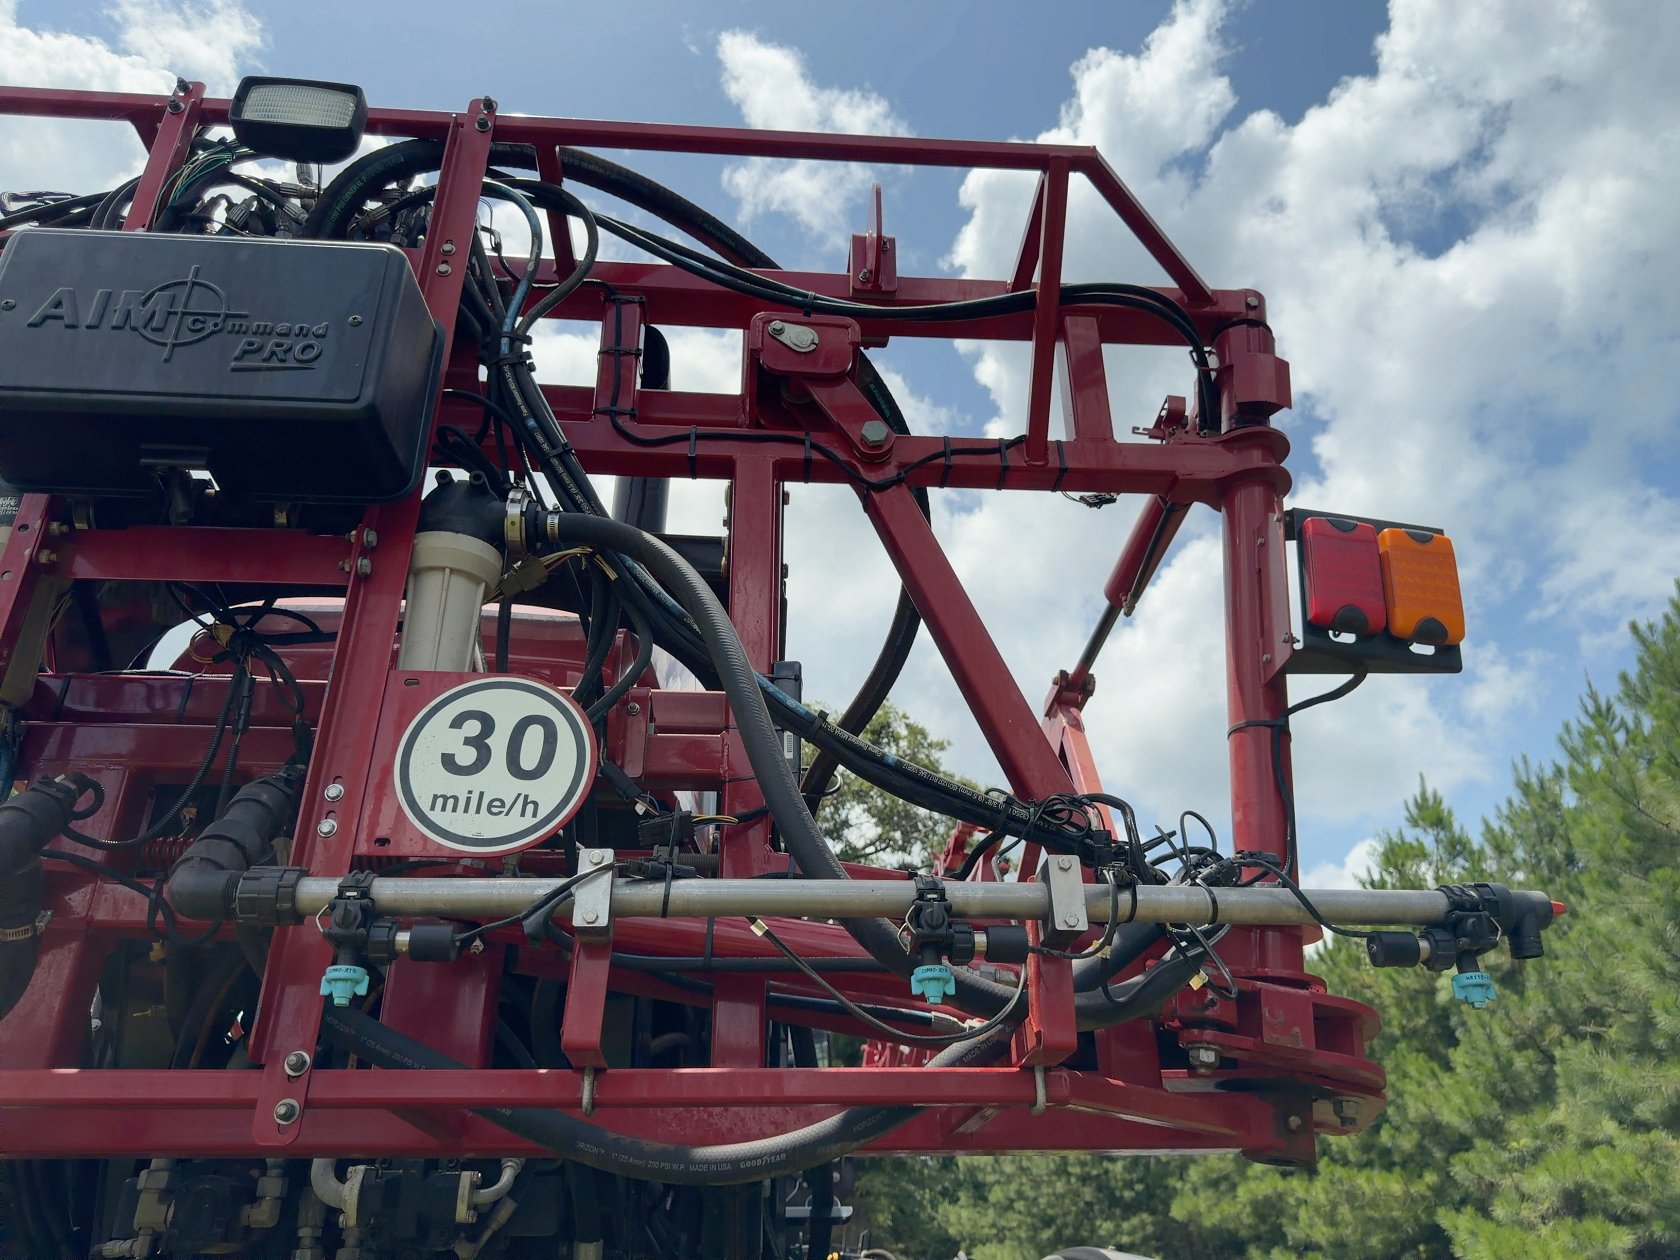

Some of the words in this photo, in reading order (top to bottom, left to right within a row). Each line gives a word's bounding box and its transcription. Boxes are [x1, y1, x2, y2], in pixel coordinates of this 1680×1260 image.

[25, 287, 176, 332] AIM
[187, 316, 329, 338] Command
[232, 338, 323, 364] PRO
[441, 709, 558, 781] 30
[429, 790, 540, 818] mile/h
[963, 1047, 981, 1063] MADE
[647, 1160, 659, 1168] 200
[660, 1162, 670, 1170] PSI
[690, 1164, 708, 1172] MADE
[709, 1164, 716, 1172] IN
[718, 1163, 732, 1171] USA
[740, 1153, 786, 1169] GOODYEAR
